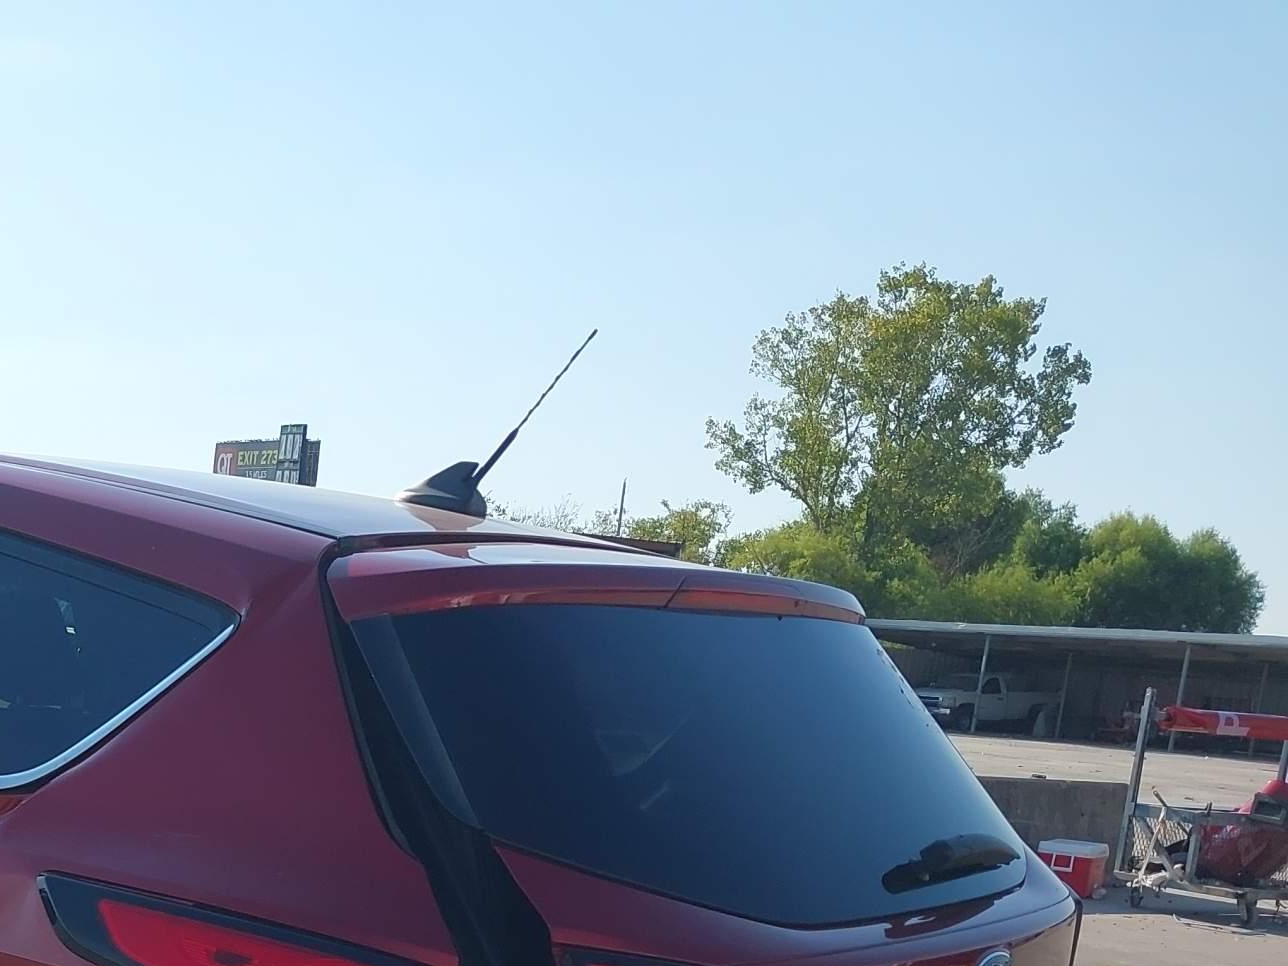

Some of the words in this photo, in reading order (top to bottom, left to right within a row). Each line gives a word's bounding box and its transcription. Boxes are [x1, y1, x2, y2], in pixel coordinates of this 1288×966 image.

[217, 453, 233, 476] QT
[237, 450, 259, 466] EXIT
[260, 449, 278, 465] 273
